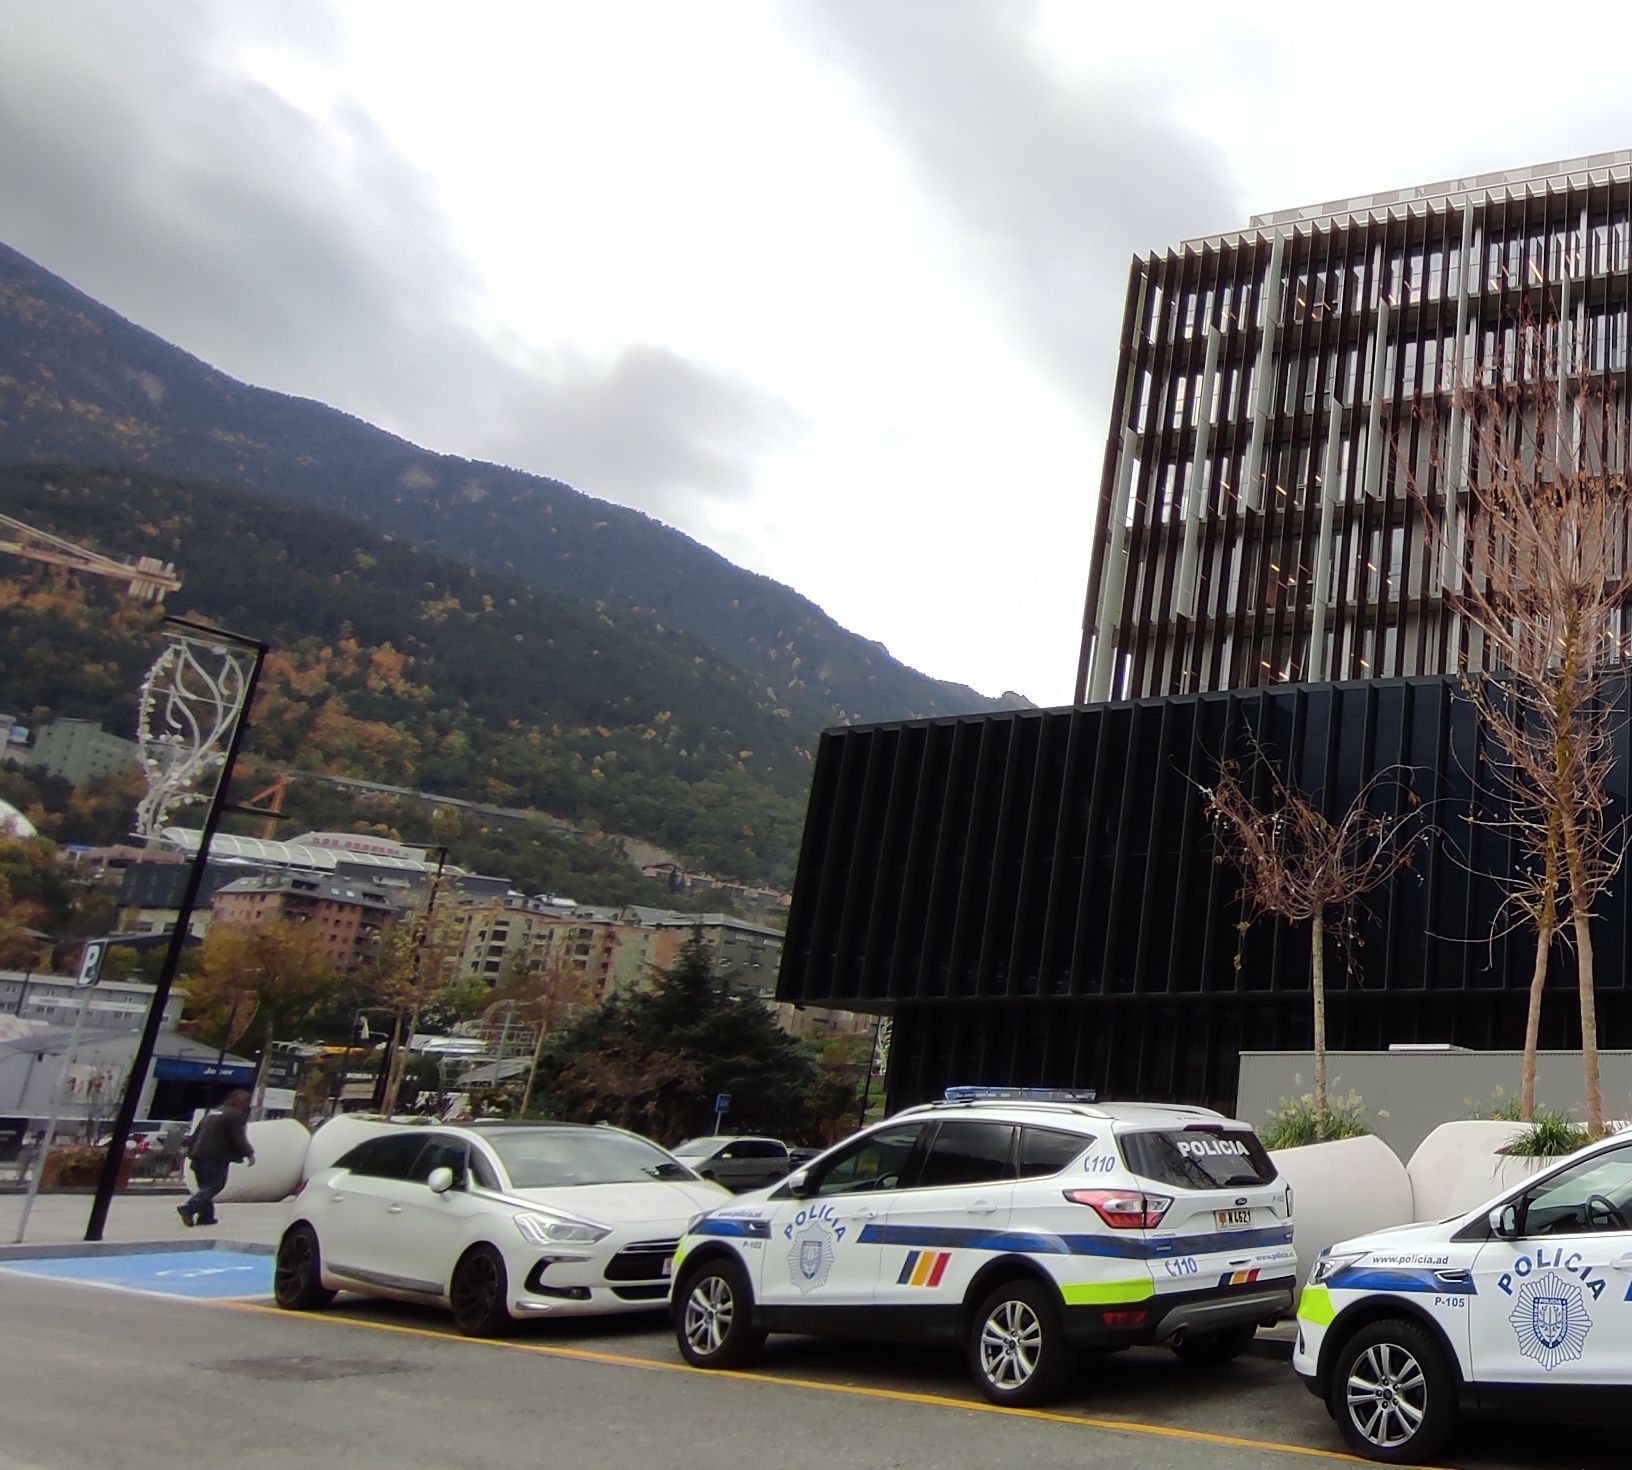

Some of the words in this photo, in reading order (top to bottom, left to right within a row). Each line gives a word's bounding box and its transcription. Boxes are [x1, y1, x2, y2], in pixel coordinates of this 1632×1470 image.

[78, 945, 100, 984] P
[1177, 1141, 1250, 1158] POLICIA
[1092, 1156, 1116, 1173] 110
[784, 1204, 846, 1242] POLICIA
[1173, 1257, 1198, 1276] 110
[1372, 1254, 1449, 1265] www.policia.ad
[1497, 1248, 1606, 1301] POLICIA
[1434, 1296, 1465, 1308] P-105
